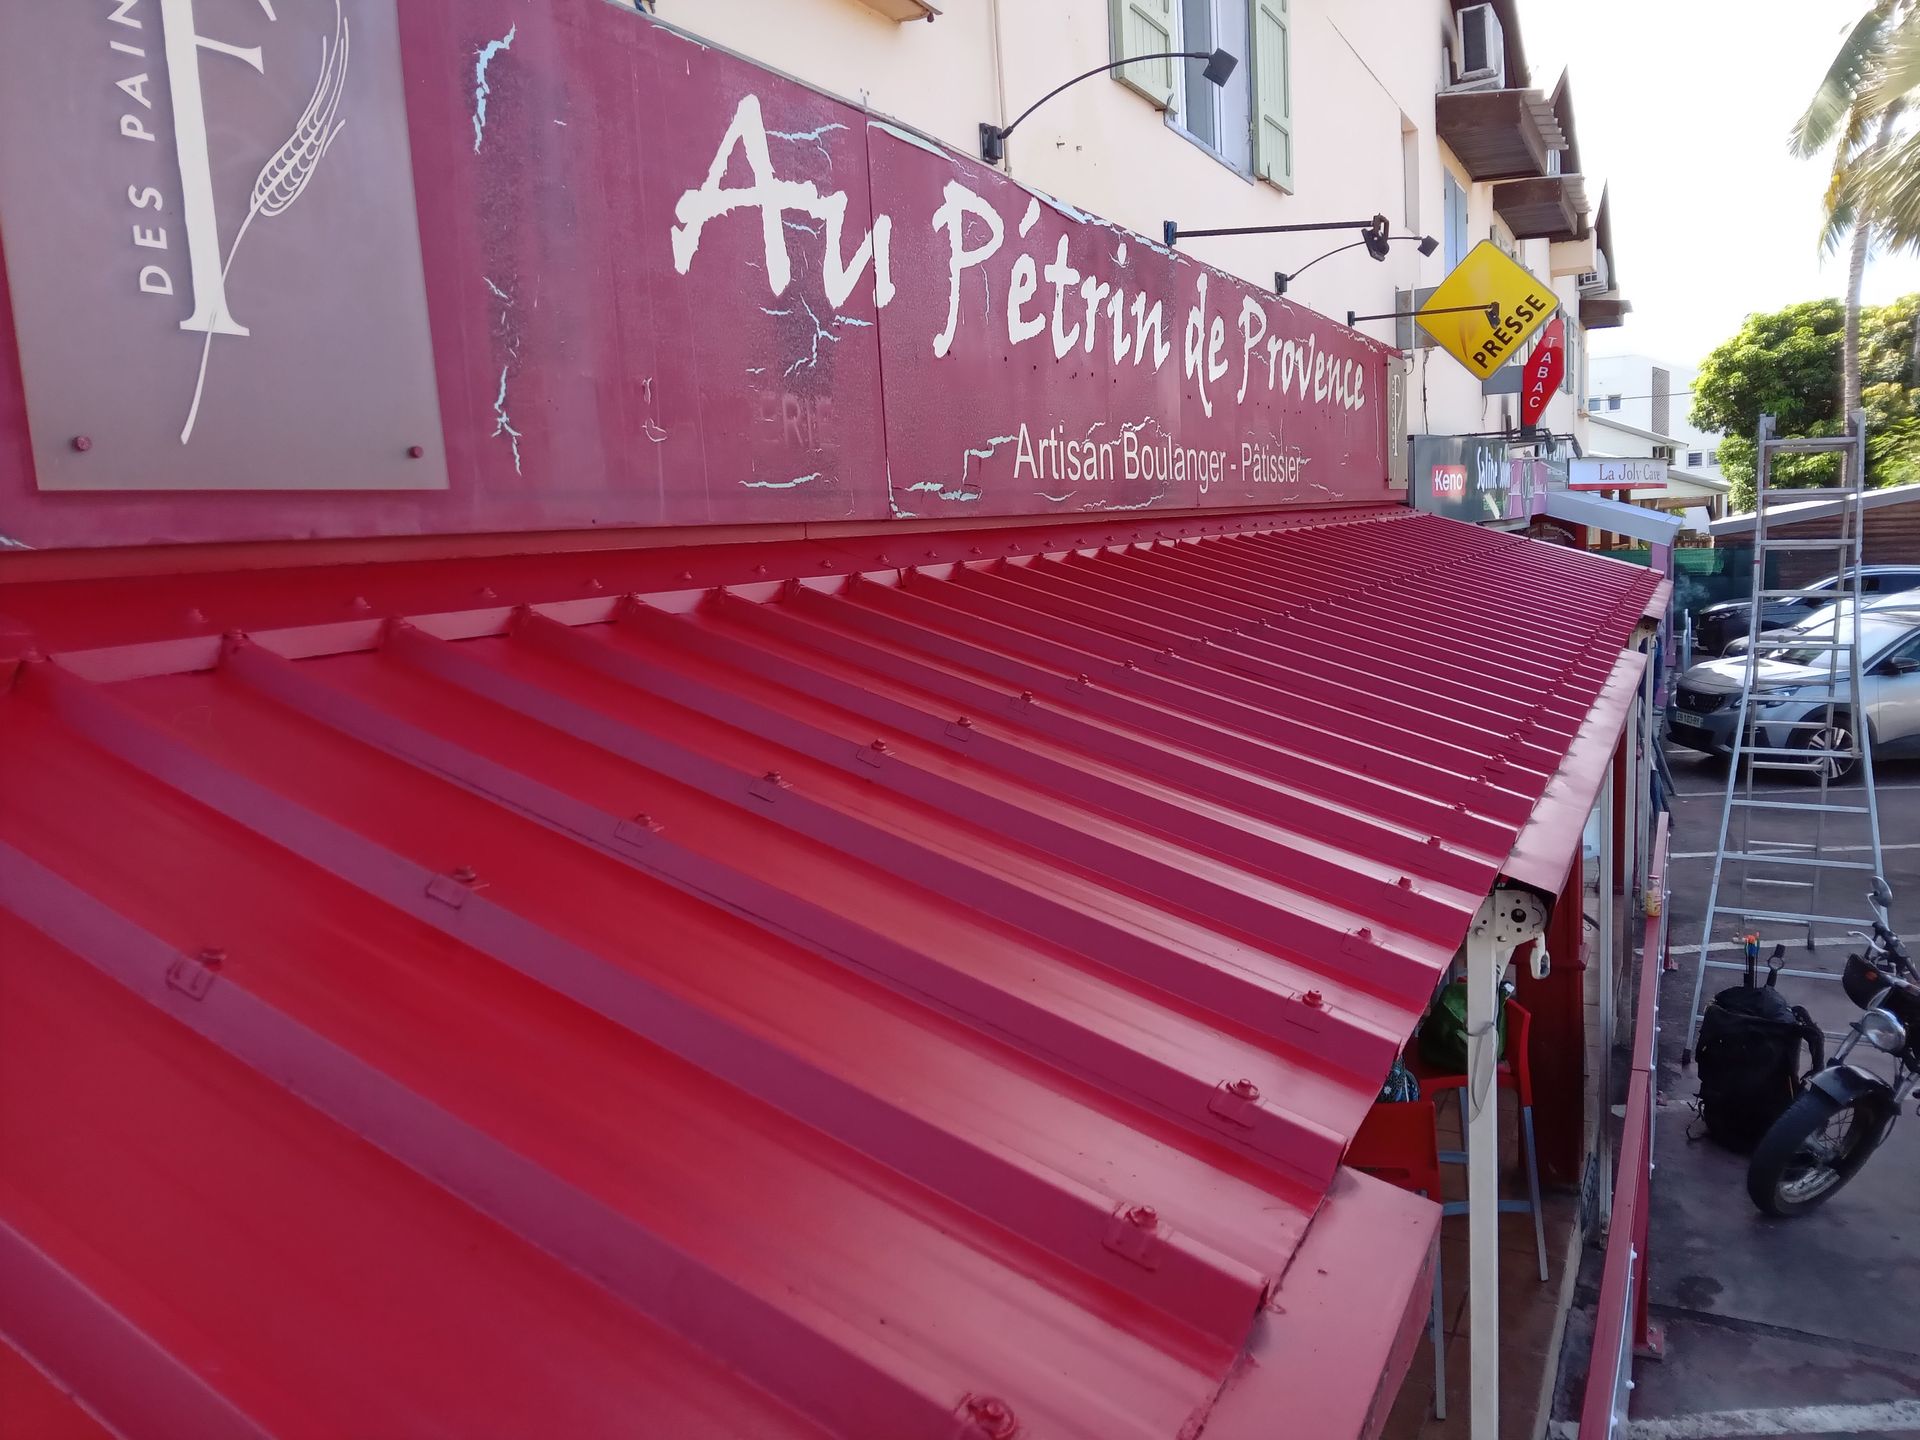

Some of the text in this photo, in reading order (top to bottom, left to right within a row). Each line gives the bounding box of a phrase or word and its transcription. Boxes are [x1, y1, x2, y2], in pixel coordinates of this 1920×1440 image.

[128, 184, 174, 295] DES
[671, 93, 896, 309] Au
[932, 180, 1171, 375] Pétrin
[1184, 272, 1229, 418] de
[1237, 295, 1365, 411] Provence
[1473, 294, 1547, 370] PRESSE
[1529, 337, 1557, 408] TABAC
[1013, 423, 1114, 481] Artisan
[1123, 431, 1226, 494] Boulanger
[1241, 442, 1300, 483] Pâtissier
[1435, 470, 1463, 491] Keno
[1599, 463, 1615, 481] La
